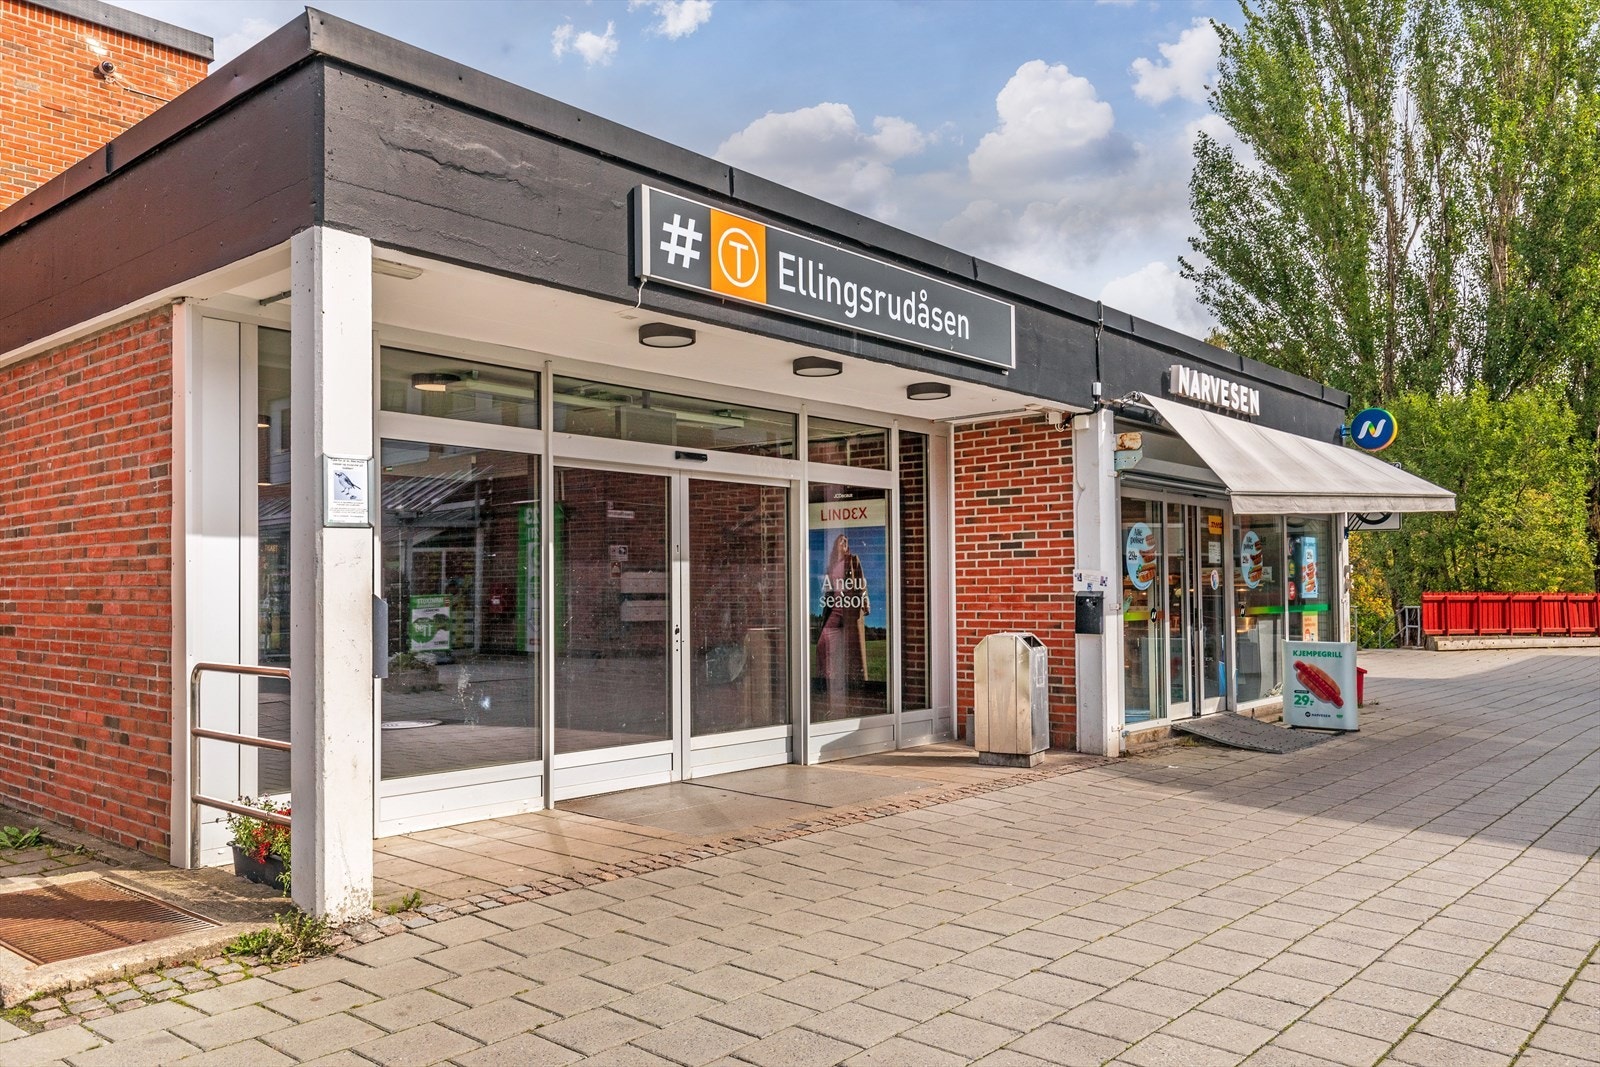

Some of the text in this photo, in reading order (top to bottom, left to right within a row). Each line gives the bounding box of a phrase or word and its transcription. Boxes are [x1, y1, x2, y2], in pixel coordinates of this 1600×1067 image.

[778, 250, 970, 340] Ellingsrudåsen
[1174, 364, 1260, 416] NARVESEN
[820, 506, 868, 522] LINDEX
[821, 574, 867, 590] A new
[819, 595, 870, 608] season
[1292, 649, 1343, 659] KJEMPEGRILL
